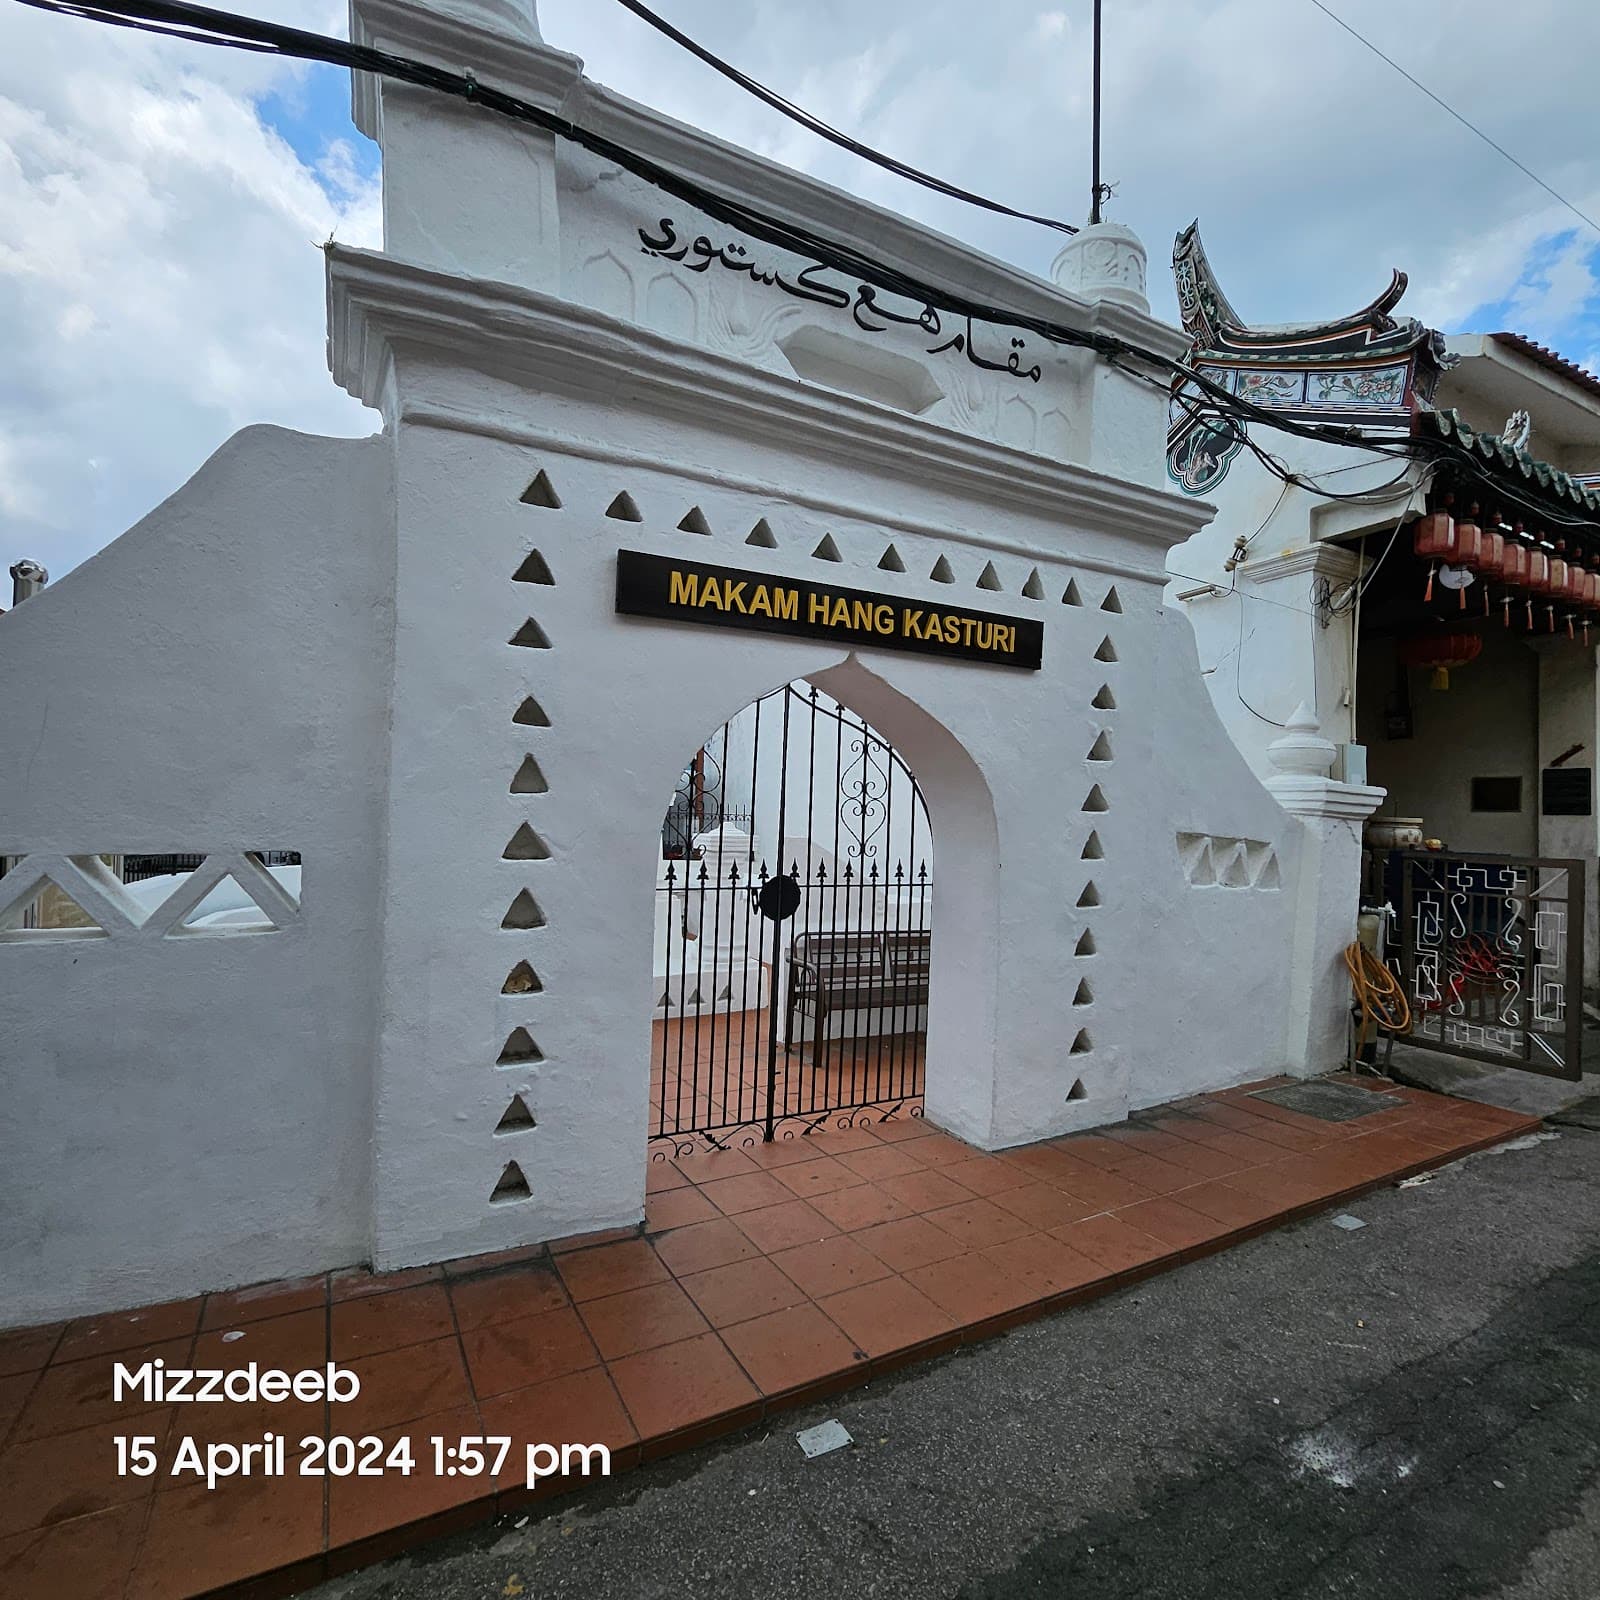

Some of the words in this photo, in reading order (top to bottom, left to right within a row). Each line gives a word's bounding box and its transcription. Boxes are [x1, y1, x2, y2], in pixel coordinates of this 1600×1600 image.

[926, 315, 1041, 383] مقام
[669, 571, 799, 621] MAKAM
[808, 592, 895, 635] HANG
[903, 609, 1016, 653] KASTURI
